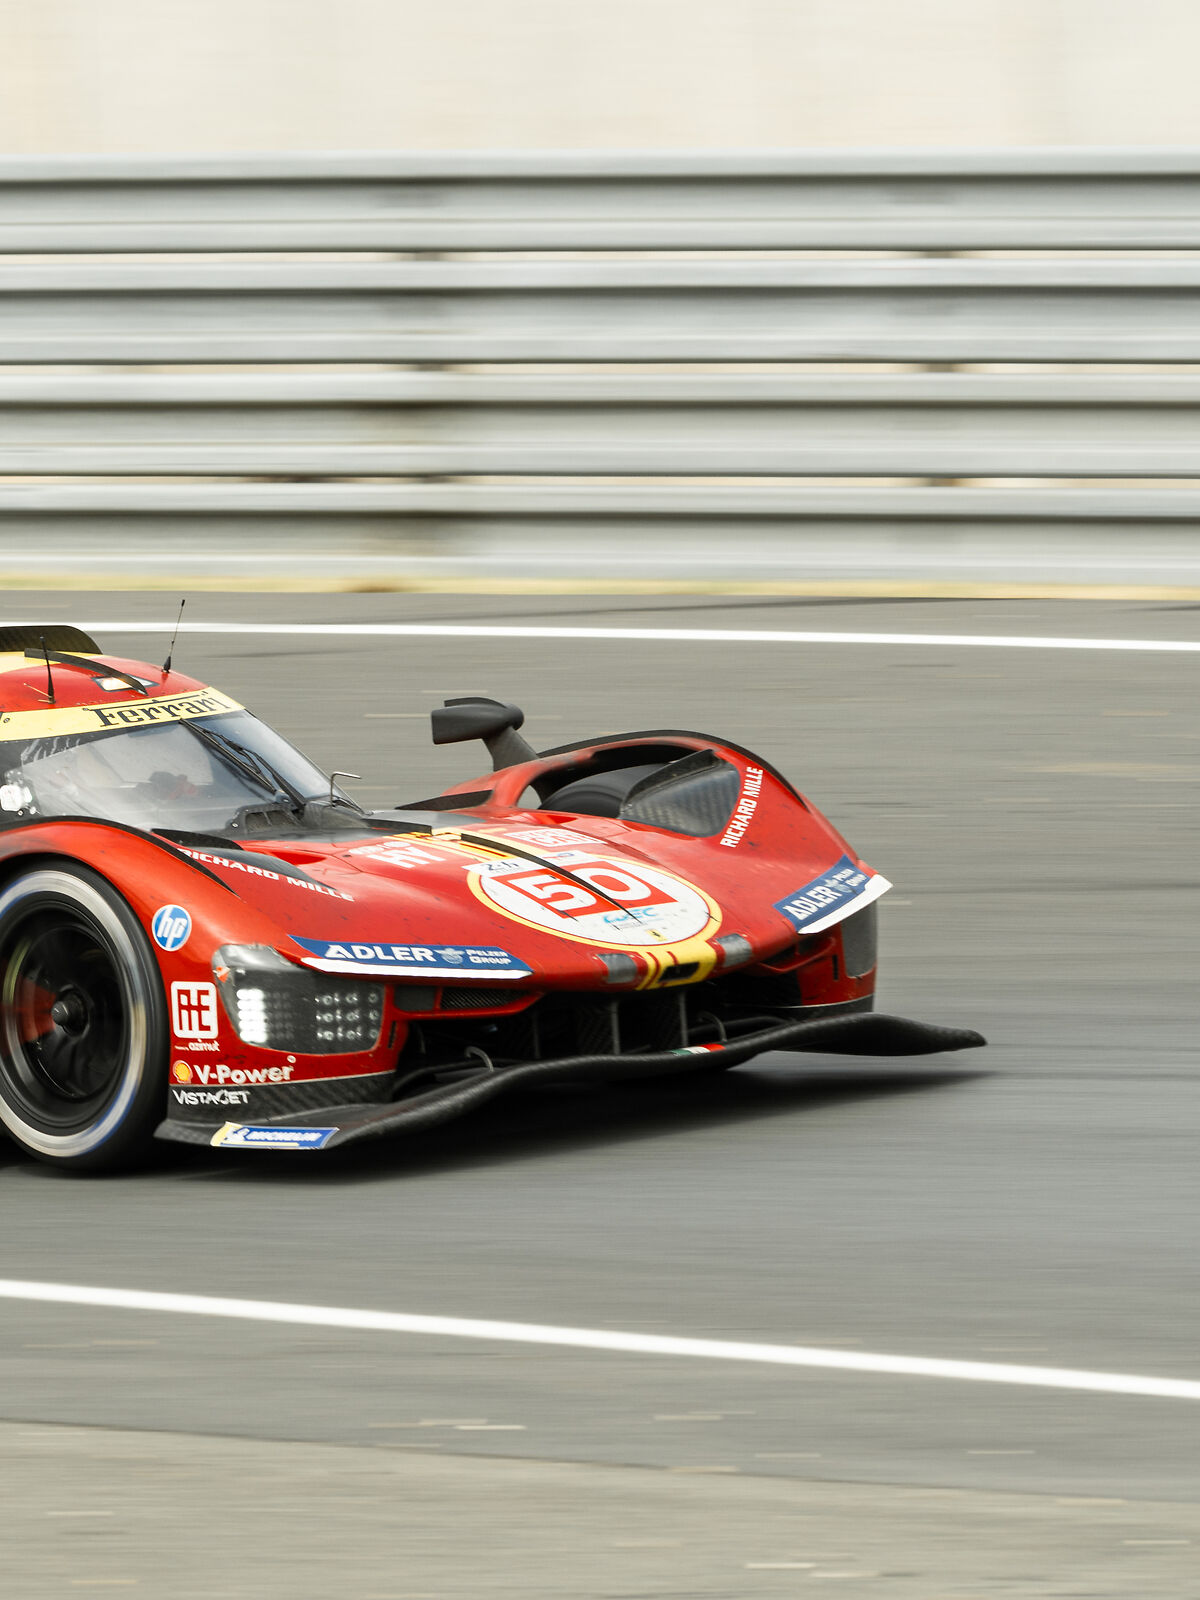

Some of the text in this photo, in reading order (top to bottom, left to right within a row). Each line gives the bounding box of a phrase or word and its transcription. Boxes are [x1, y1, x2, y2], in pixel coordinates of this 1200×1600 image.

[88, 690, 233, 728] Ferrari
[720, 766, 764, 848] RICHARD MILLE
[177, 847, 356, 902] RICHARD MILLE
[507, 868, 652, 912] 50
[782, 884, 843, 921] ADLER
[156, 906, 190, 950] hp
[324, 944, 437, 962] ADLER
[193, 1065, 294, 1084] V-Power
